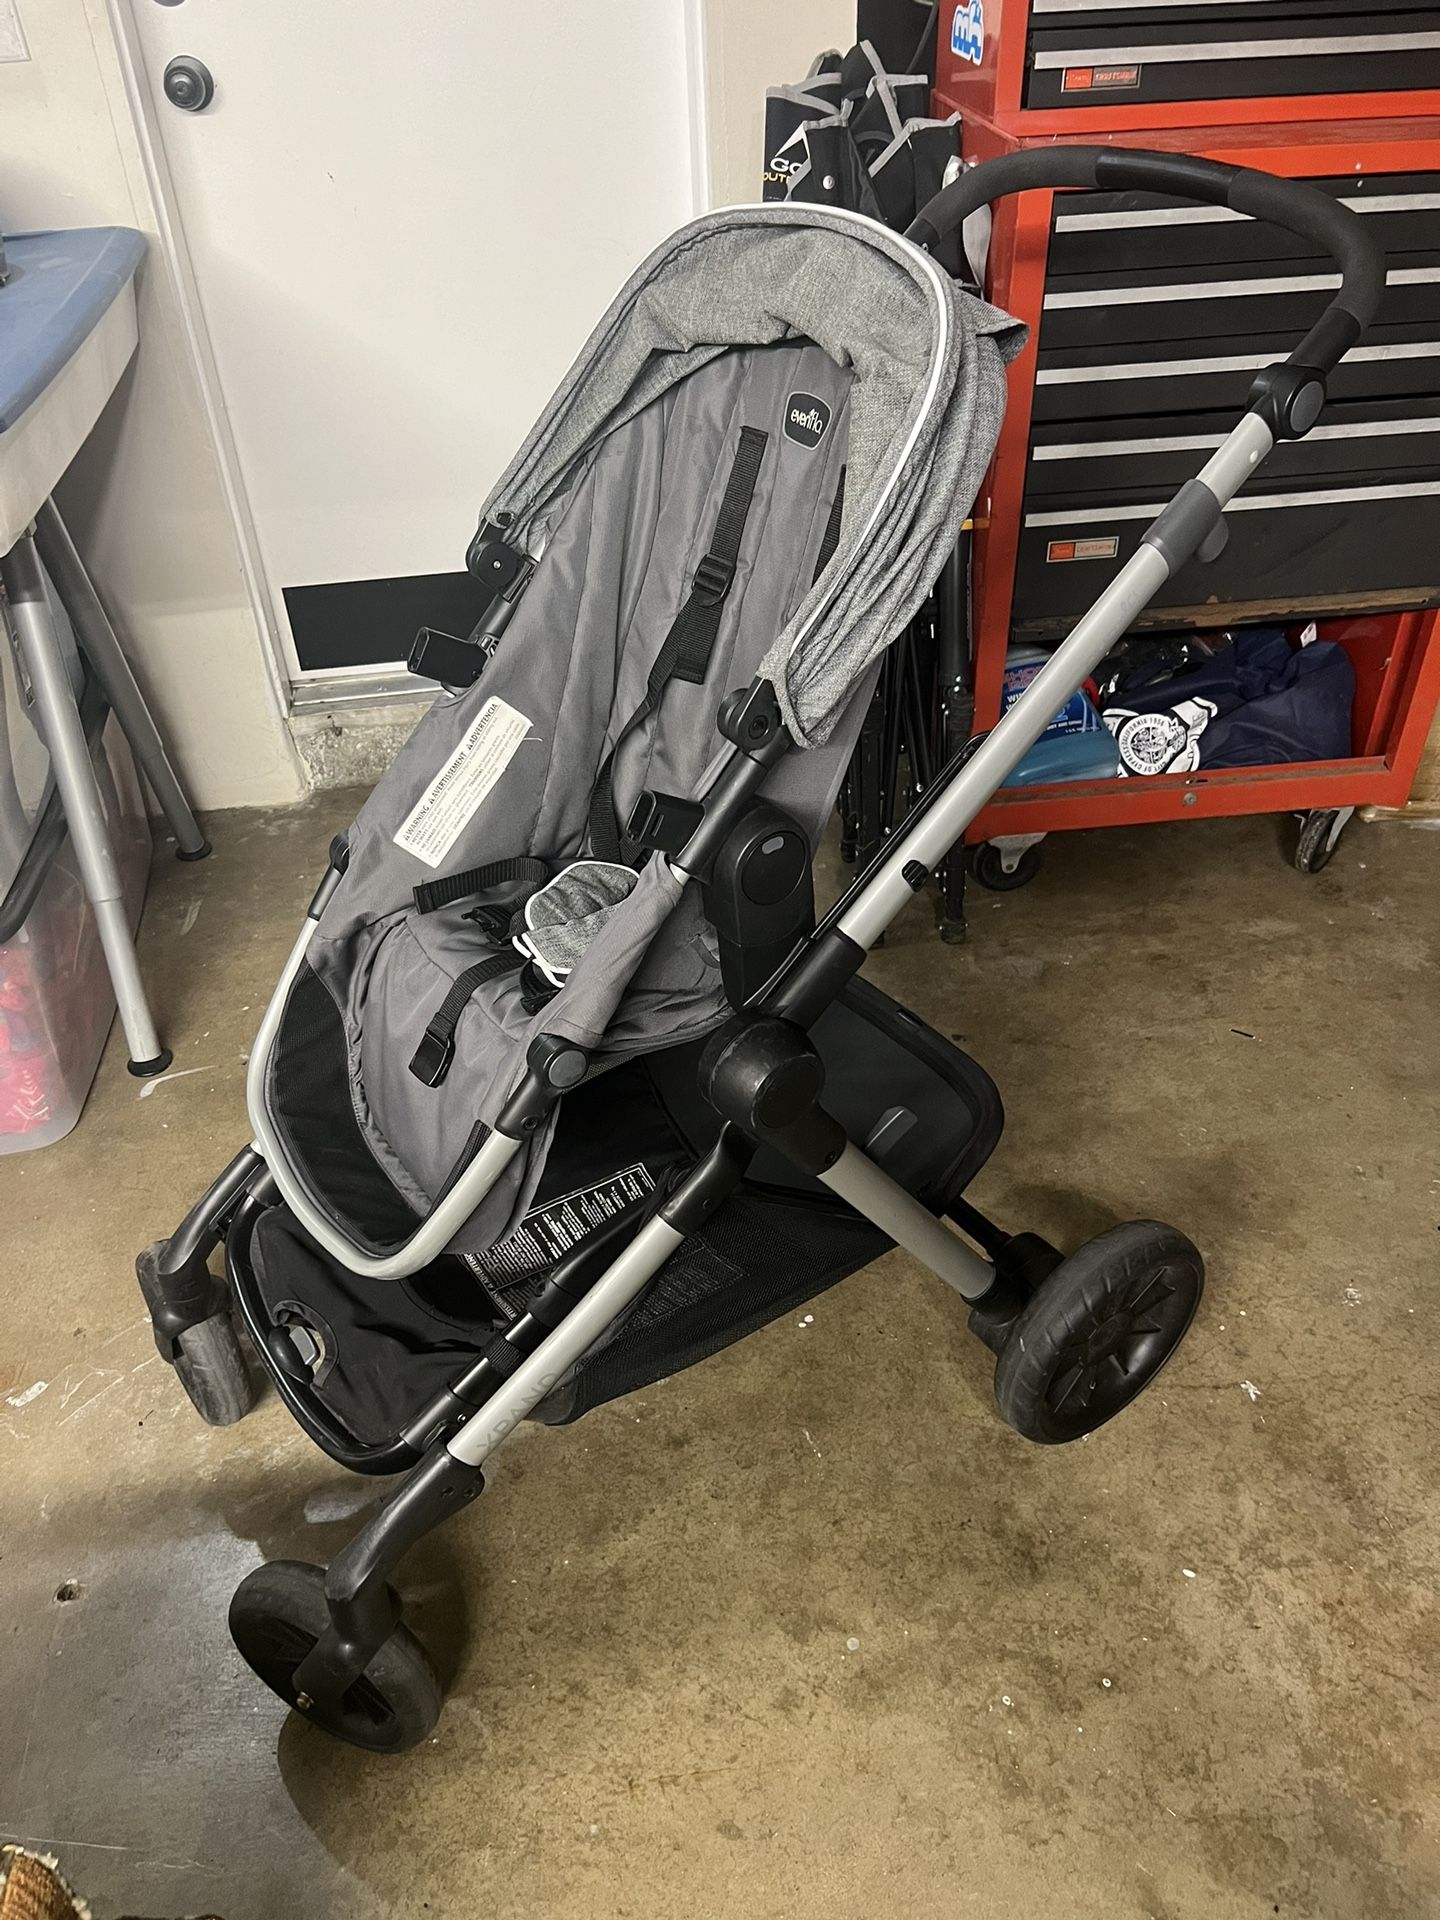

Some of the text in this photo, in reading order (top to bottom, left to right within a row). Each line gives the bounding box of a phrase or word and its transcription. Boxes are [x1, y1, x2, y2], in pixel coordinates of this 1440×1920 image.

[790, 408, 823, 435] evenflo
[405, 703, 498, 836] WARNING AVERTISSEMENT ADVERTENCIA
[475, 1372, 559, 1454] XPAND
